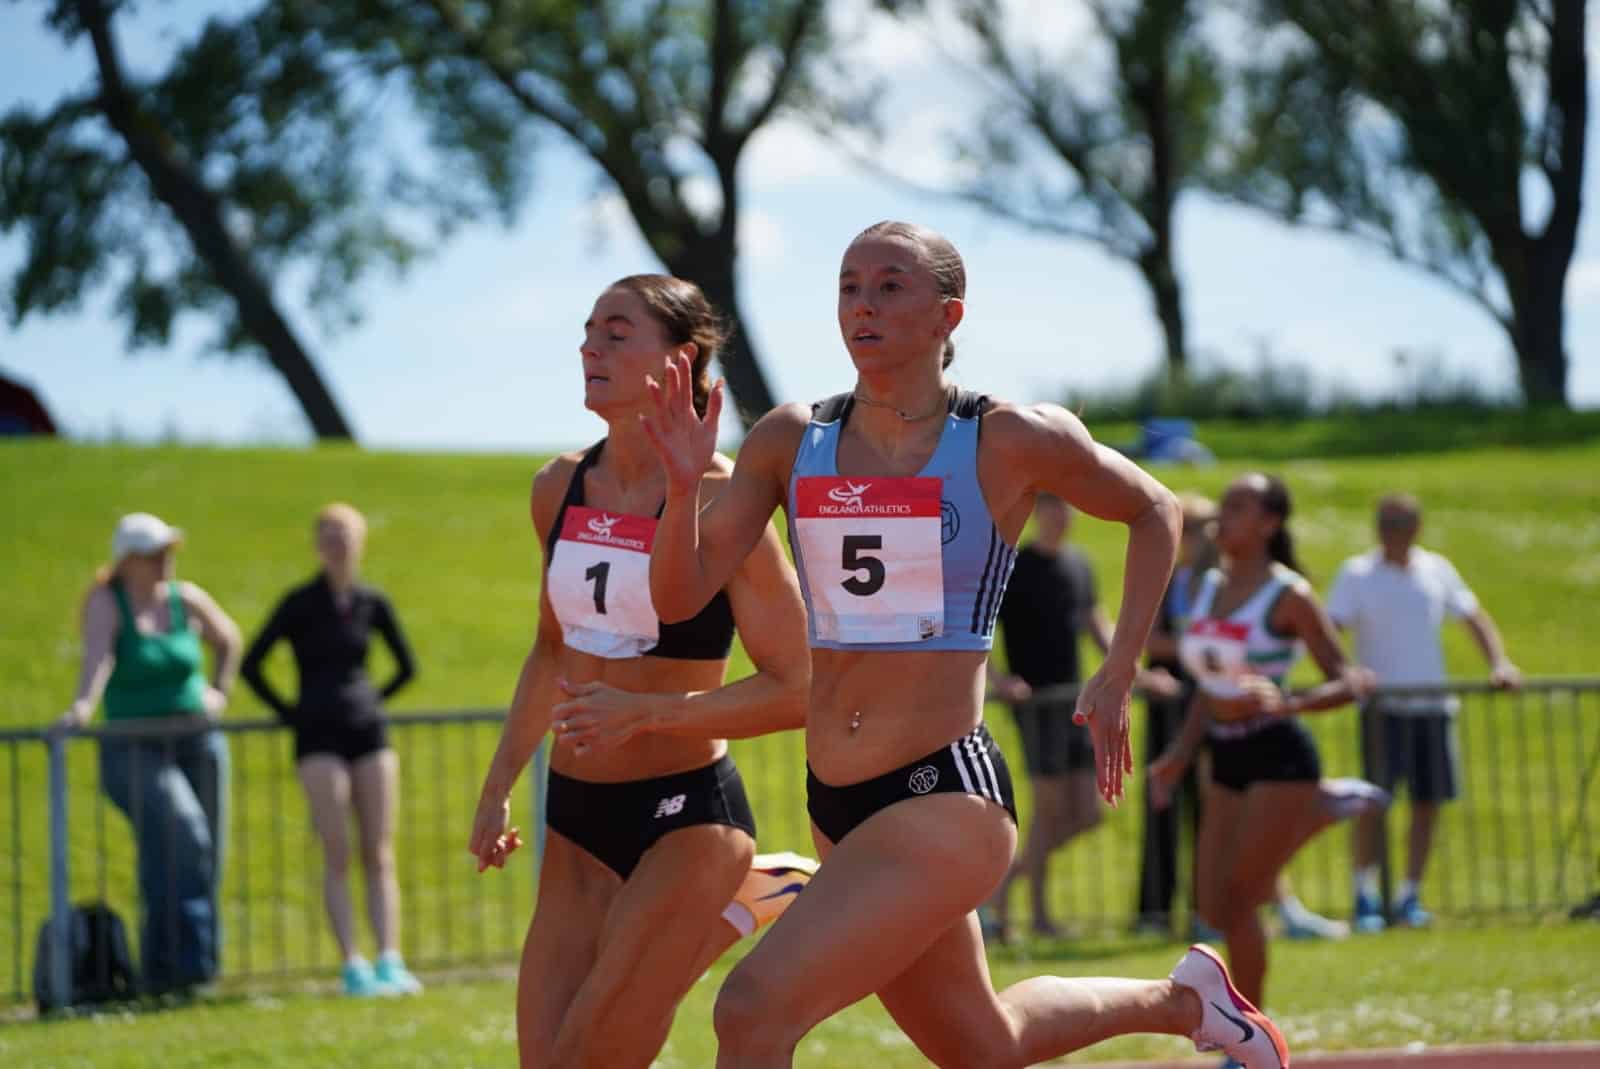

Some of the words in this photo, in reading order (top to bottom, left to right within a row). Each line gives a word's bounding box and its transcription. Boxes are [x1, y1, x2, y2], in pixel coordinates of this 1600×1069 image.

[864, 504, 911, 514] ATHLETICS
[585, 561, 610, 615] 1
[841, 535, 885, 596] 5
